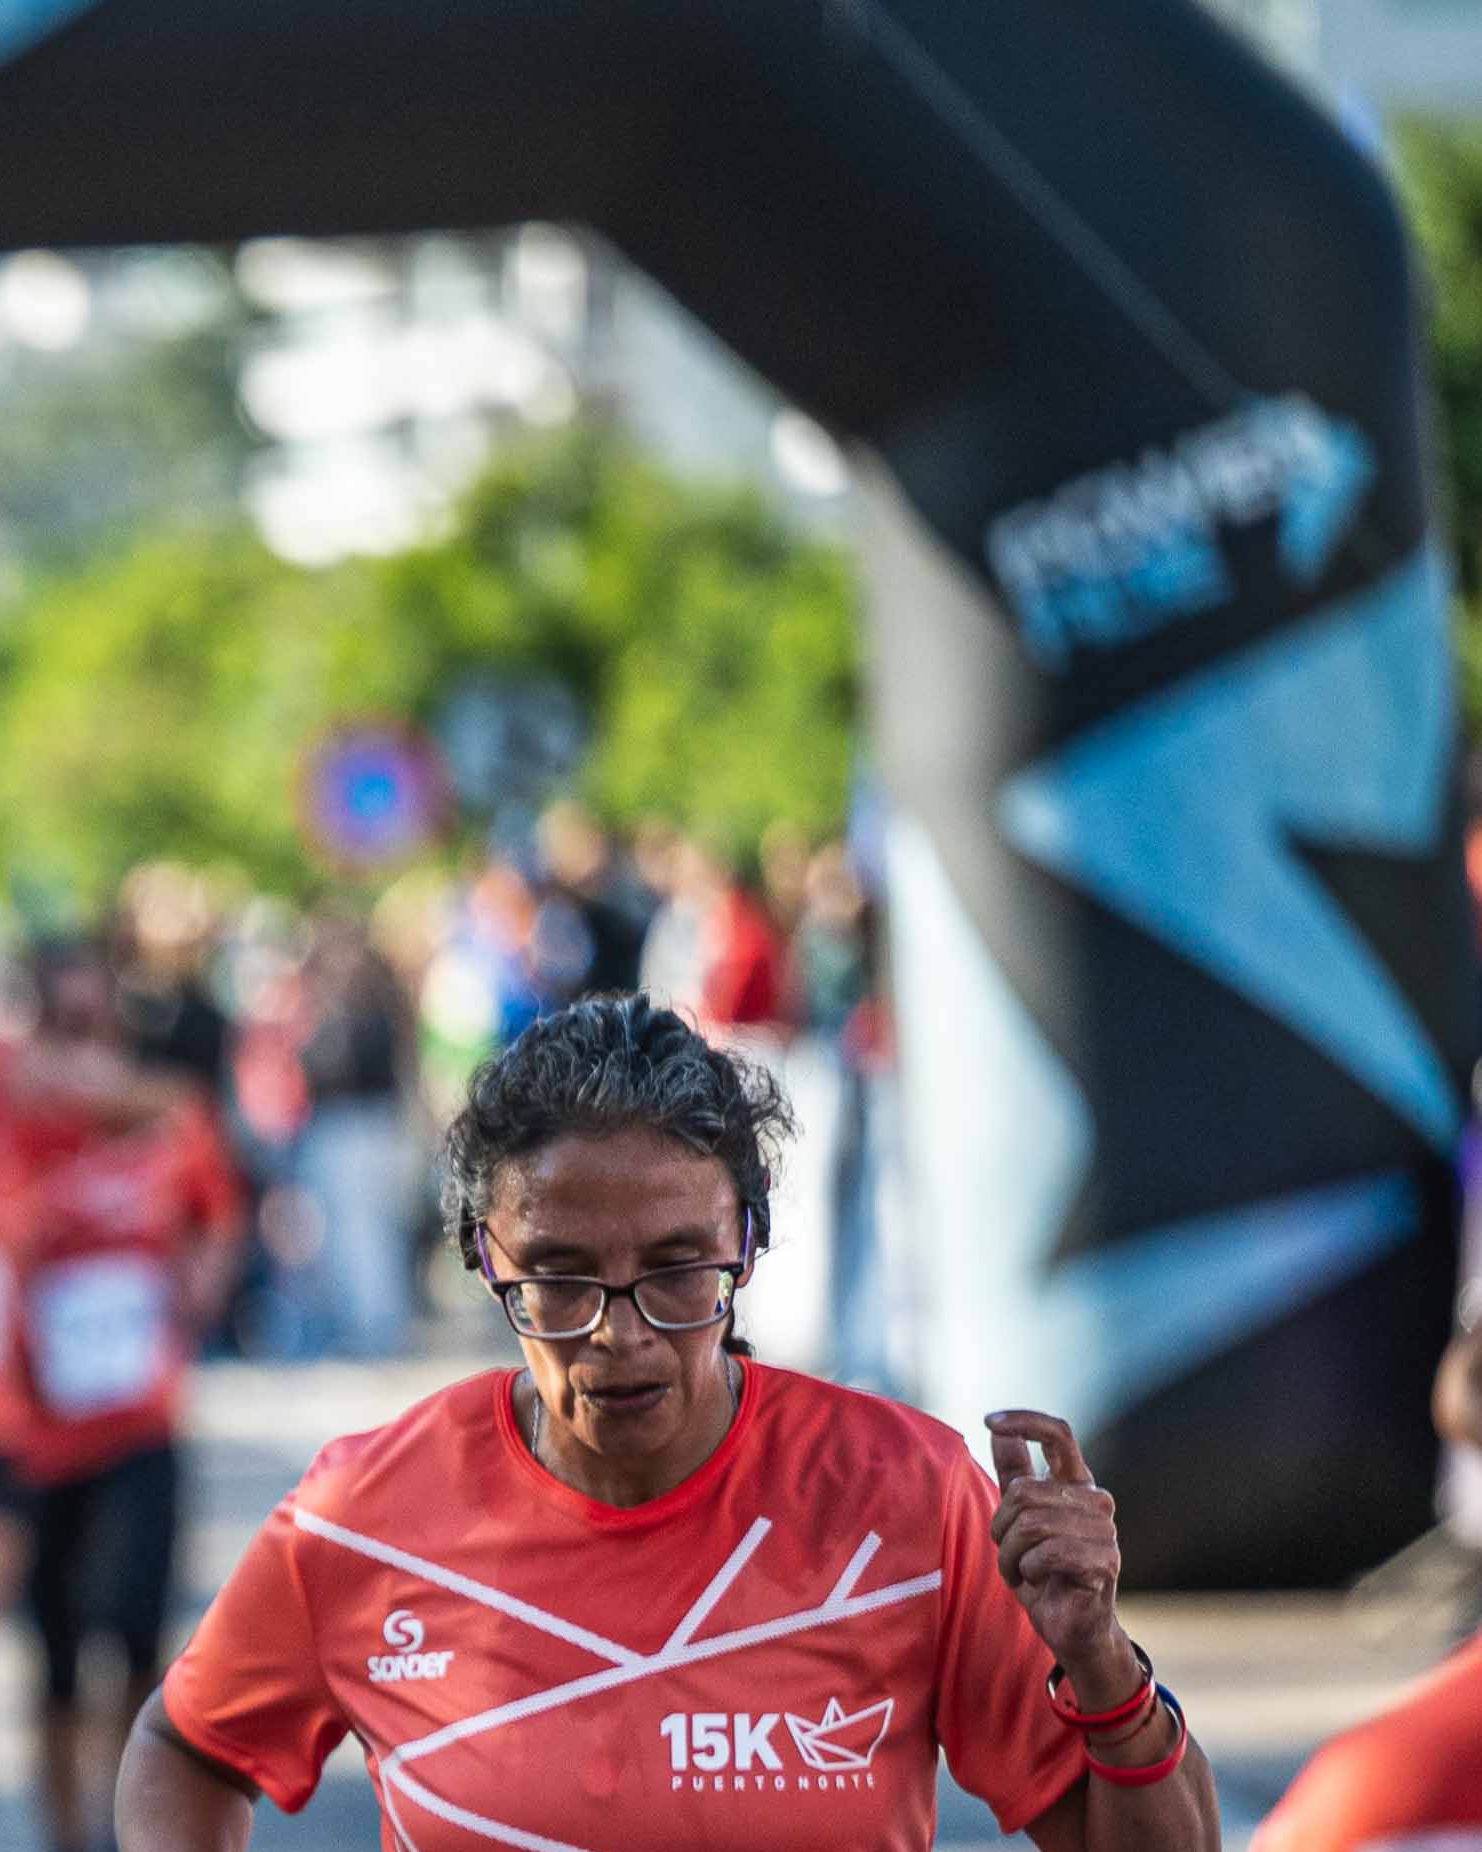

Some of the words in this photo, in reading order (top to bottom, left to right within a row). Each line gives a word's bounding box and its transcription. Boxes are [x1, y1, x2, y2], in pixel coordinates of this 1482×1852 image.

[659, 1712, 784, 1771] 15K
[671, 1774, 786, 1792] PUERTO
[798, 1773, 876, 1791] NORTE
